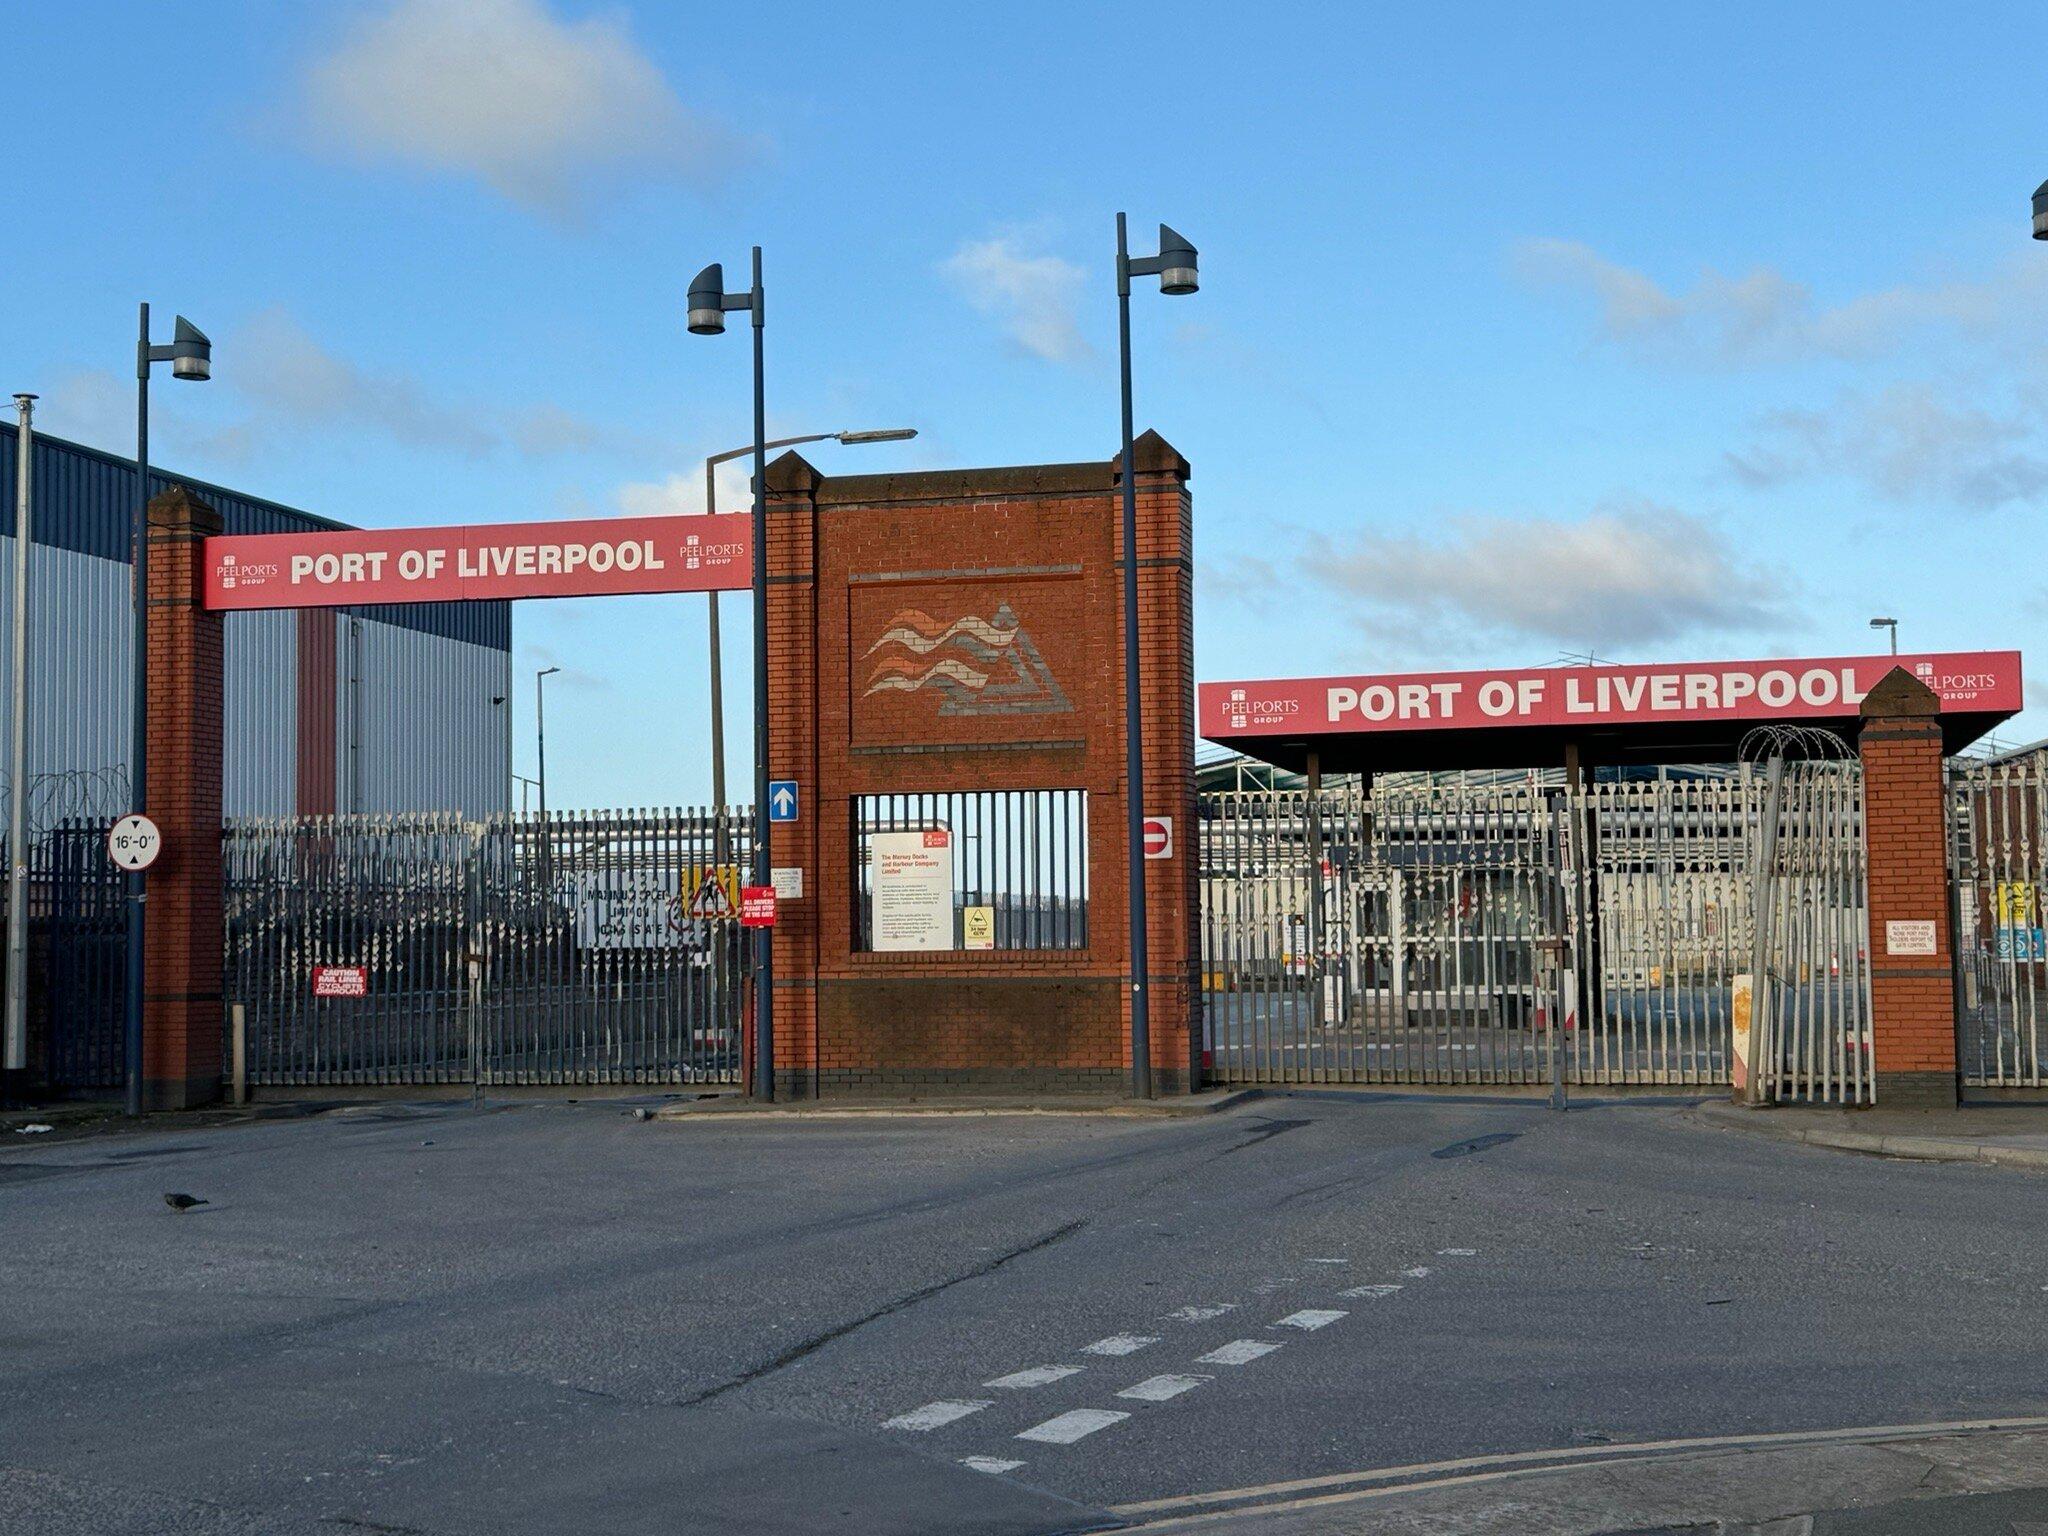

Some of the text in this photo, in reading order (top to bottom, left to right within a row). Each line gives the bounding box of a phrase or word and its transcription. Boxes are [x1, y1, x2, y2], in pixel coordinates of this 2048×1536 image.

[291, 540, 665, 584] PORT OF LIVERPOOL
[1327, 668, 1869, 722] PORT OF LIVERPOOL
[1943, 692, 1977, 700] GROUP
[1254, 716, 1283, 724] GROUP
[318, 975, 337, 983] RAIL
[318, 982, 364, 990] CYCLISTS
